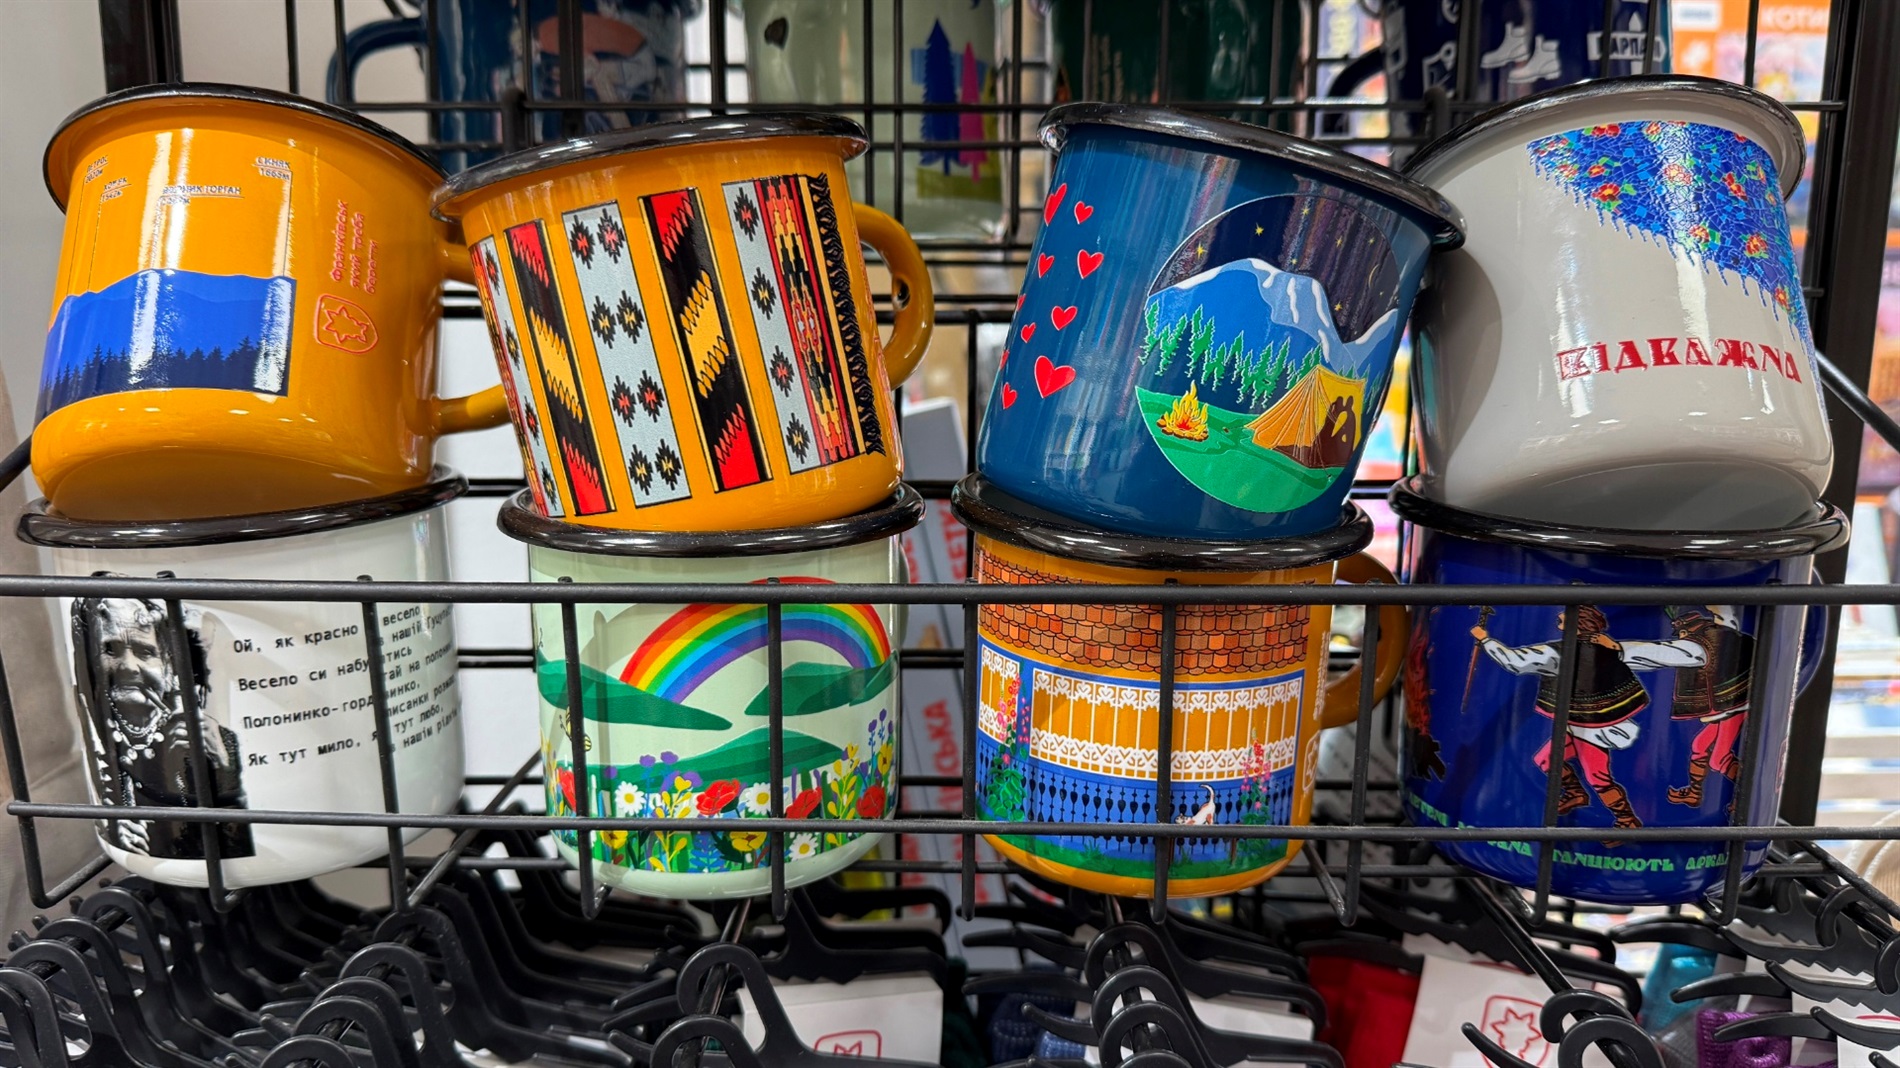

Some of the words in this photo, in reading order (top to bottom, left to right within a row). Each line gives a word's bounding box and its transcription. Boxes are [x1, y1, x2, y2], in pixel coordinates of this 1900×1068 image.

[329, 199, 348, 281] Франківськ
[351, 212, 364, 250] треба
[350, 253, 361, 288] який
[364, 240, 378, 294] берегти
[233, 639, 262, 653] Ой,
[275, 636, 294, 648] як
[304, 624, 359, 646] красно
[383, 605, 420, 626] весело
[392, 622, 422, 642] нашій
[238, 674, 298, 691] Весело
[309, 669, 327, 681] си
[409, 660, 421, 673] на
[248, 753, 268, 766] Як
[279, 748, 306, 764] тут
[317, 738, 361, 756] мило,
[394, 716, 413, 734] тут
[403, 725, 433, 748] нашім
[1684, 850, 1730, 871] АРКА
